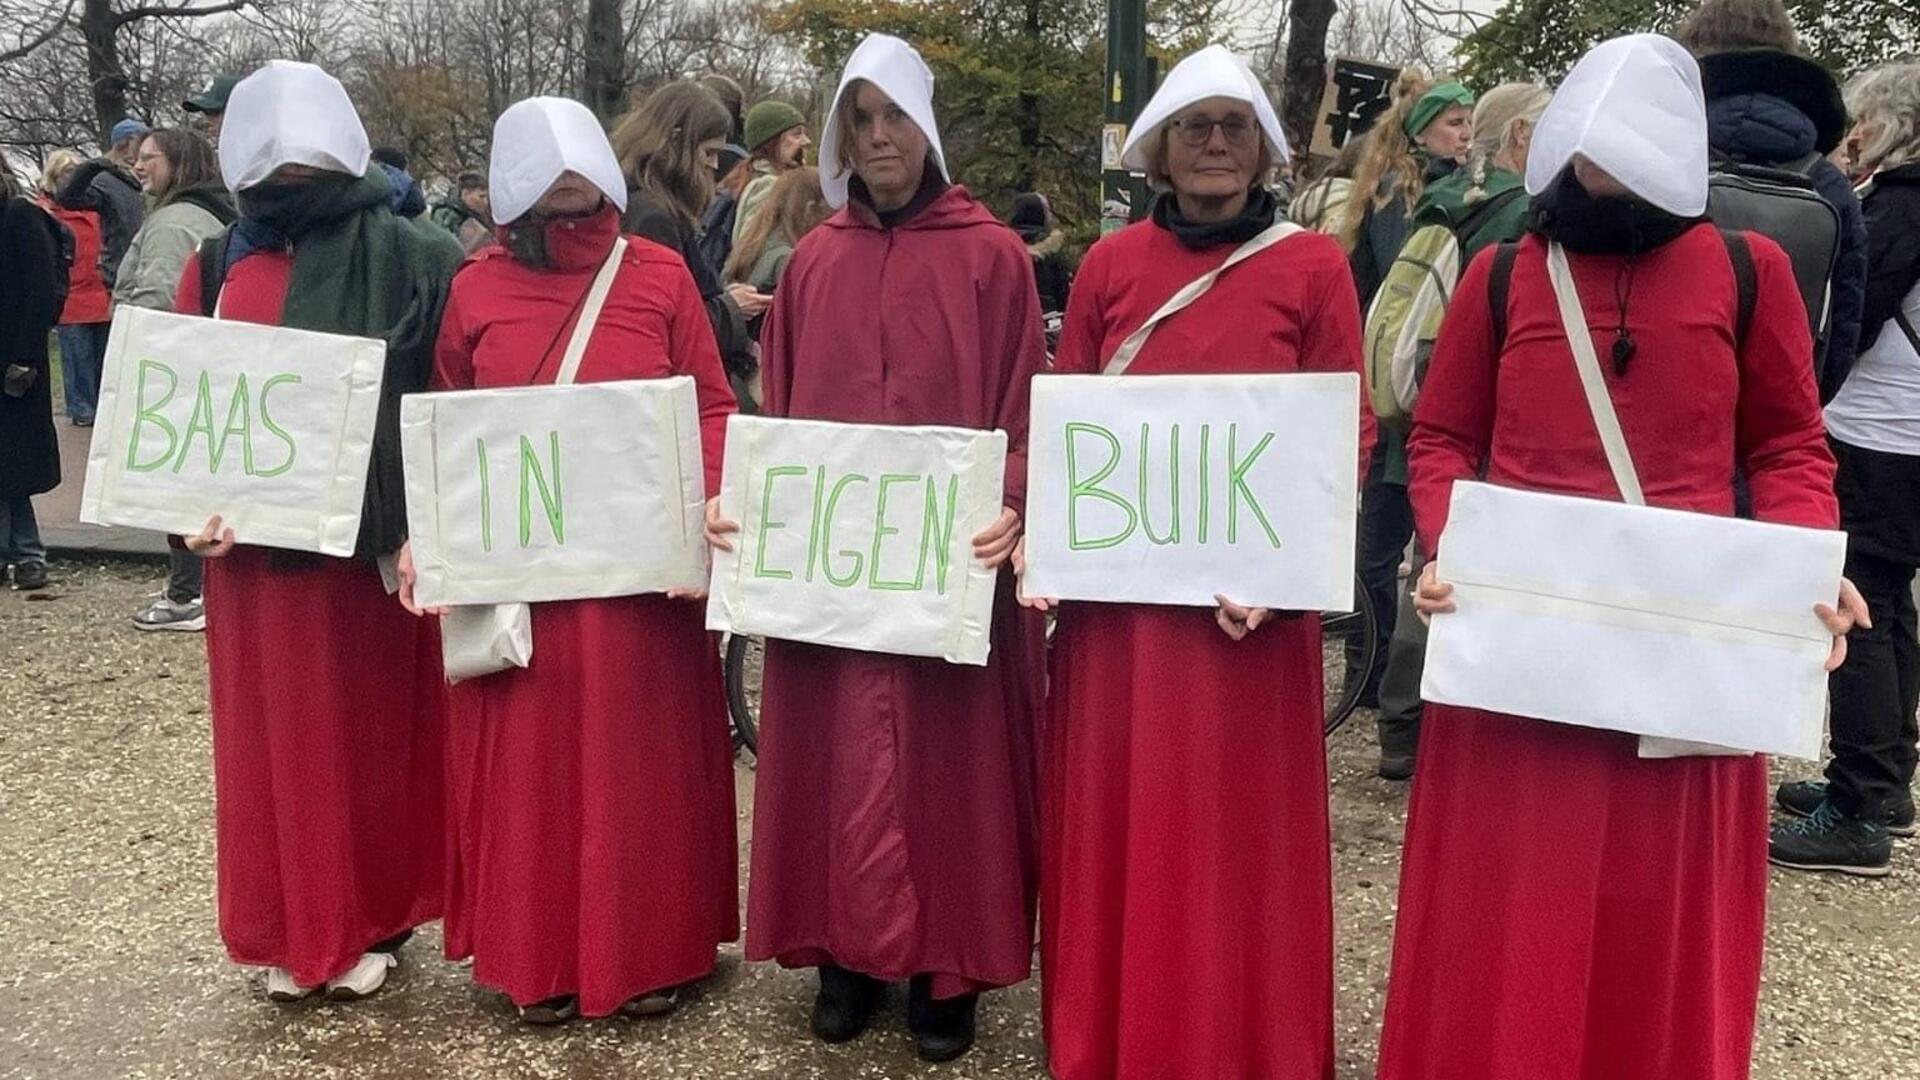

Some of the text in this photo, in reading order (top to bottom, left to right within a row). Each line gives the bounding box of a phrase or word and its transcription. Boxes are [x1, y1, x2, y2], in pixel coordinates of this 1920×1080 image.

[126, 359, 301, 477] BAAS
[477, 430, 565, 551] IN
[755, 465, 958, 593] EIGEN
[1065, 421, 1281, 550] BUIK
